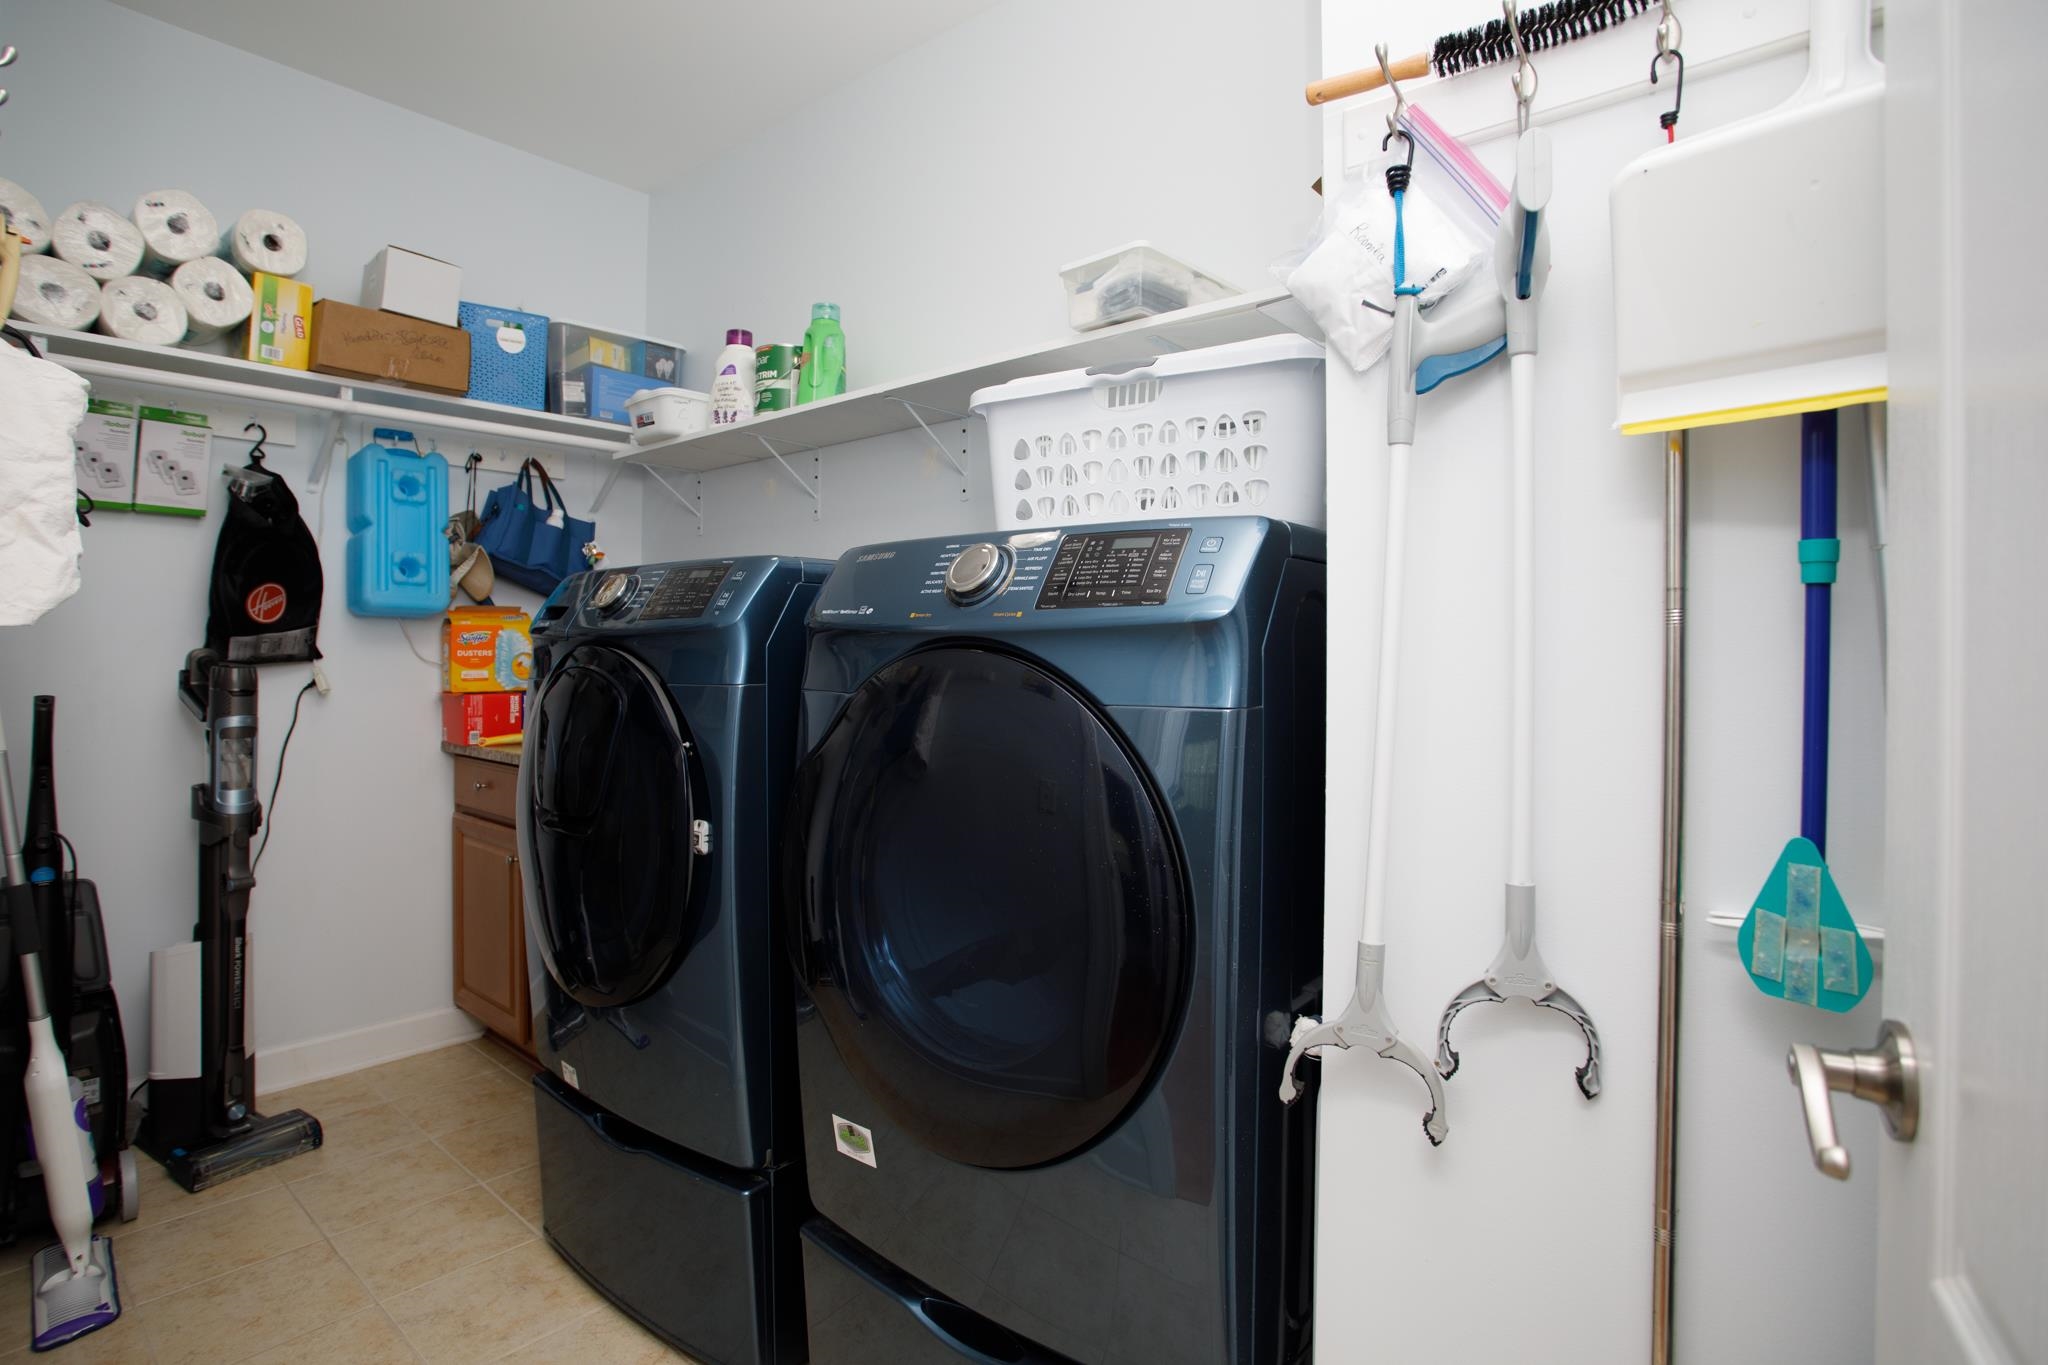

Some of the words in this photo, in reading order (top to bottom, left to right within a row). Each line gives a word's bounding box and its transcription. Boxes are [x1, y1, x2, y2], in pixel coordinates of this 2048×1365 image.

[294, 316, 305, 338] GLAD
[759, 370, 778, 379] TRIM
[857, 551, 896, 562] SAMSUNG
[460, 631, 489, 643] Swiffer
